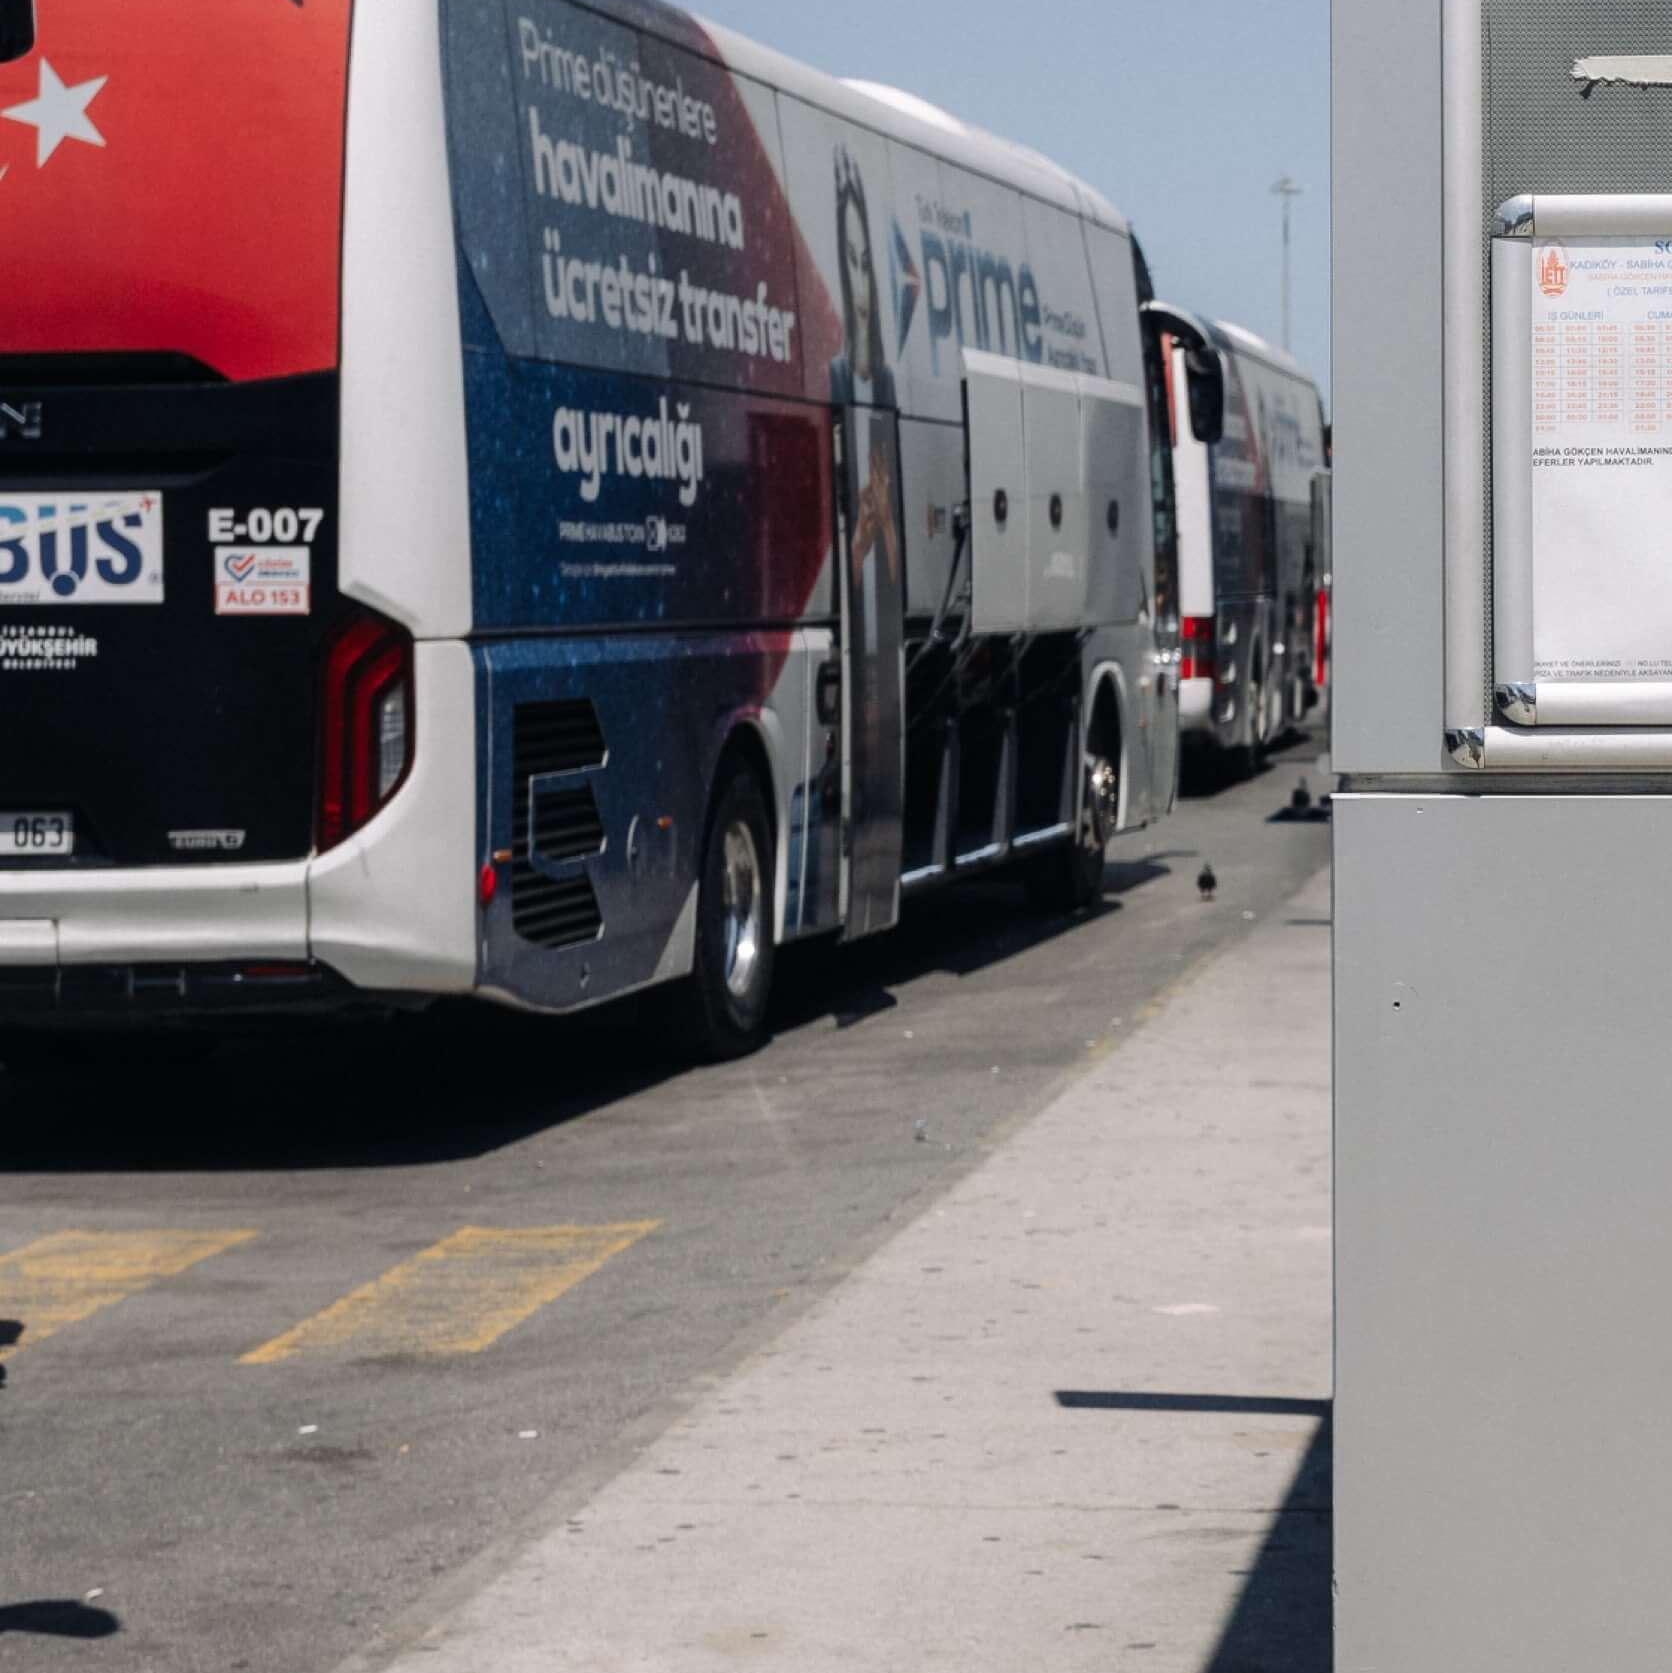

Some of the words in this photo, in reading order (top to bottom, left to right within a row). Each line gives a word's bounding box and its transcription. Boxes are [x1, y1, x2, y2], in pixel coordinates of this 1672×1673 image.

[517, 16, 592, 101] Prime
[541, 226, 678, 338] ücretsiz
[678, 269, 796, 363] transfer
[552, 394, 704, 508] ayrıcalığı
[207, 507, 324, 543] E-007
[225, 589, 266, 605] ALO
[271, 589, 301, 605] 153
[13, 816, 65, 848] 063
